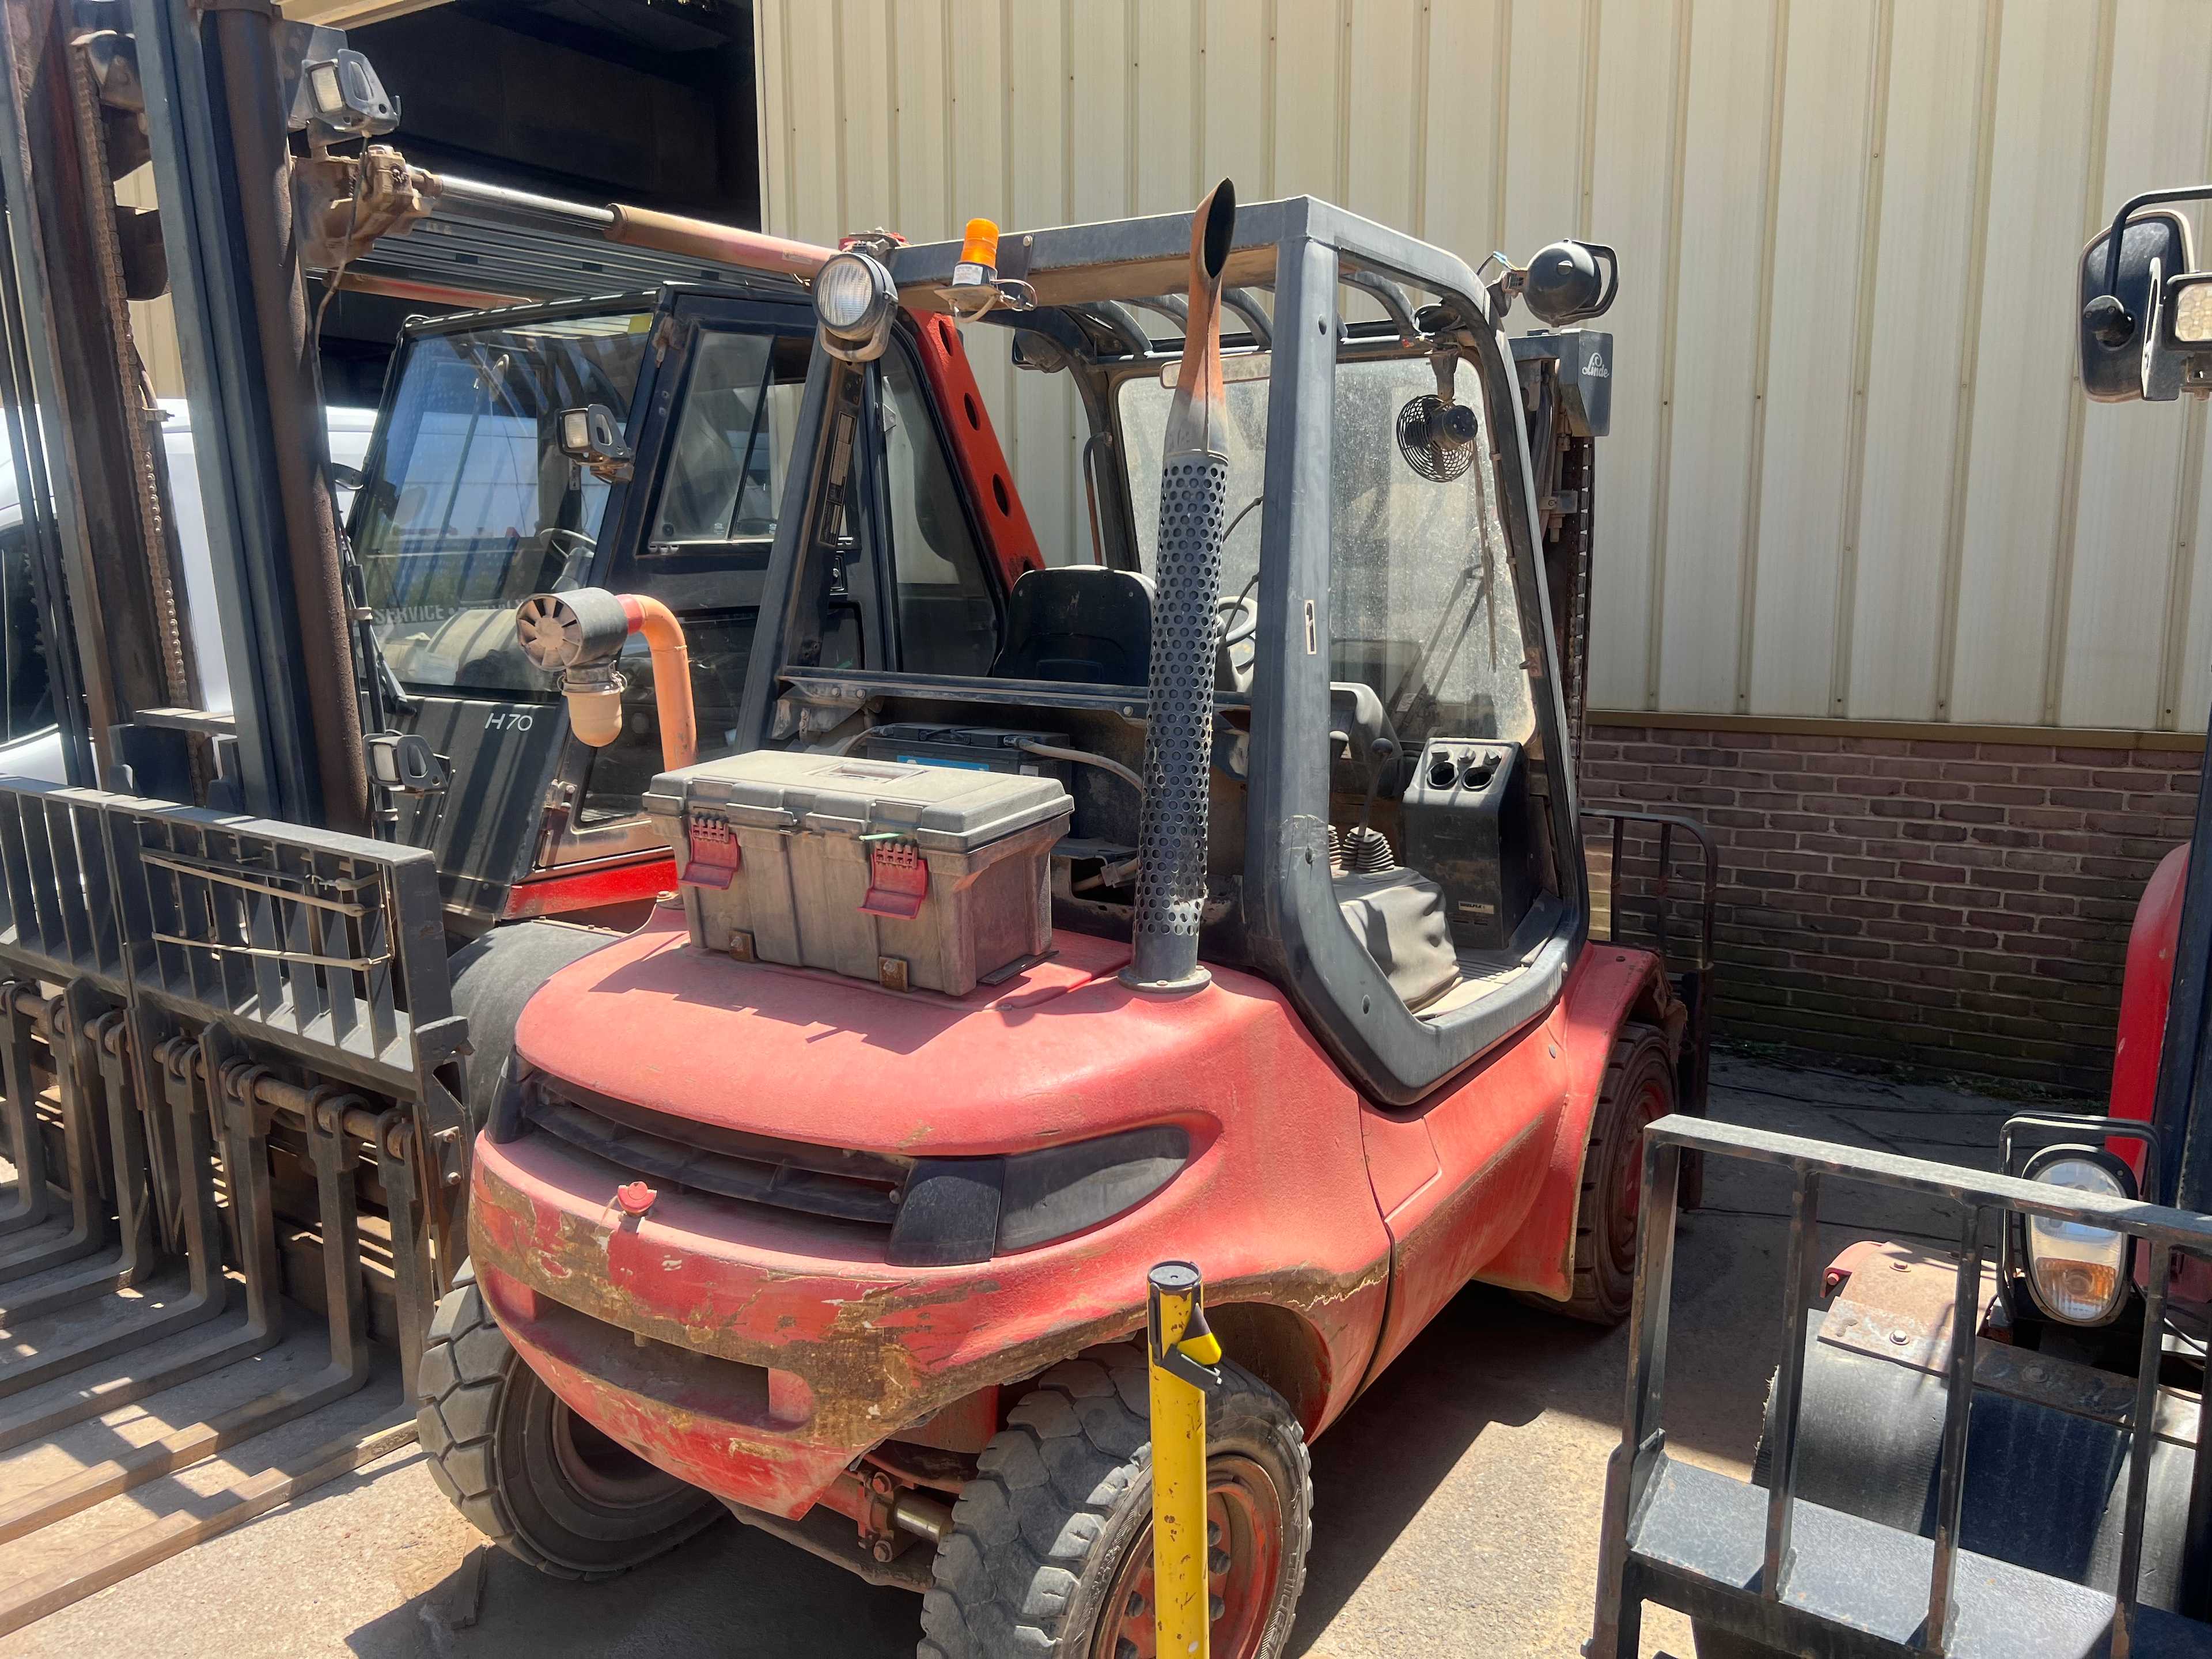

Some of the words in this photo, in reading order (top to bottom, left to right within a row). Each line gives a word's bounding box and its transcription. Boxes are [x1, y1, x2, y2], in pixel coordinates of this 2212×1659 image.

[1582, 352, 1609, 378] Linde
[374, 605, 445, 625] SERVICE
[484, 713, 533, 732] H70
